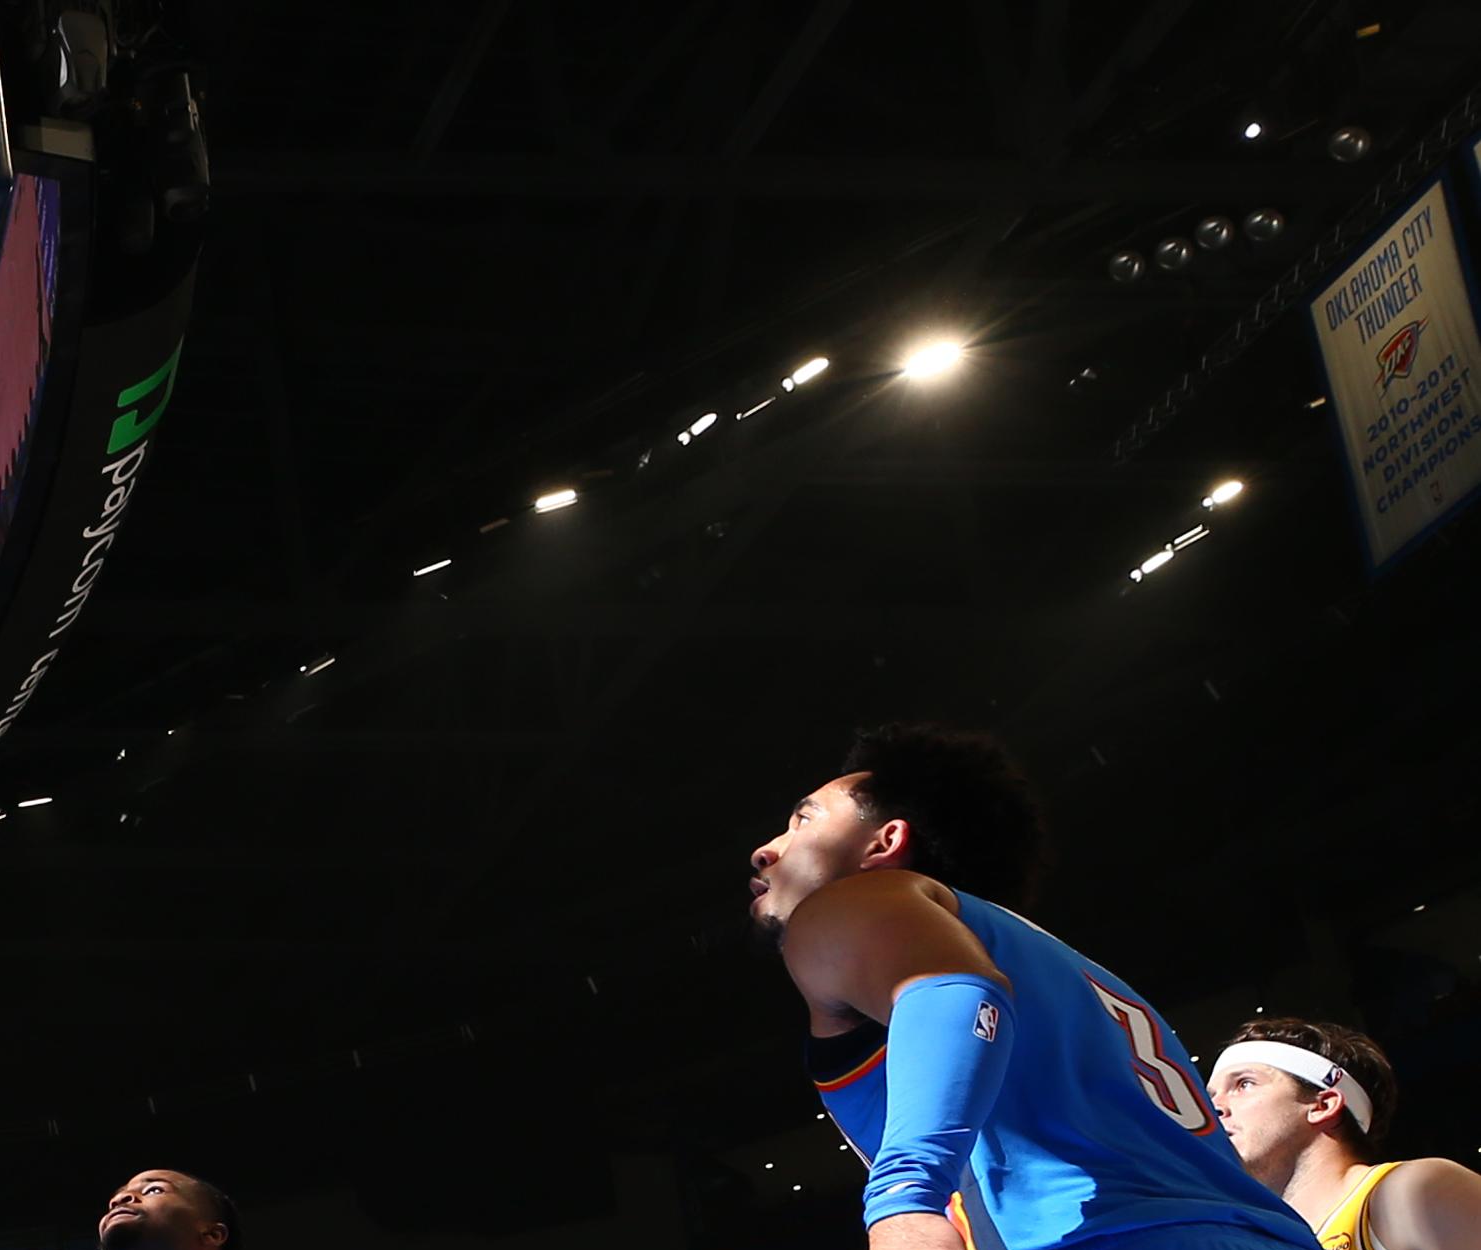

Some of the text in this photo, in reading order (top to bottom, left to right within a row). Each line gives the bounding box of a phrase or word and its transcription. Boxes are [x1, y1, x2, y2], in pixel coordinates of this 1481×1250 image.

[1325, 205, 1435, 332] OKLAHOMA CITY
[1354, 262, 1423, 346] THUNDER
[1362, 367, 1472, 474] NORTHWEST
[1365, 354, 1456, 442] 2010-2011
[1383, 409, 1464, 483] DIVISION
[1376, 414, 1481, 516] CHAMPIONS
[48, 439, 149, 639] paycom
[1084, 970, 1218, 1137] 3
